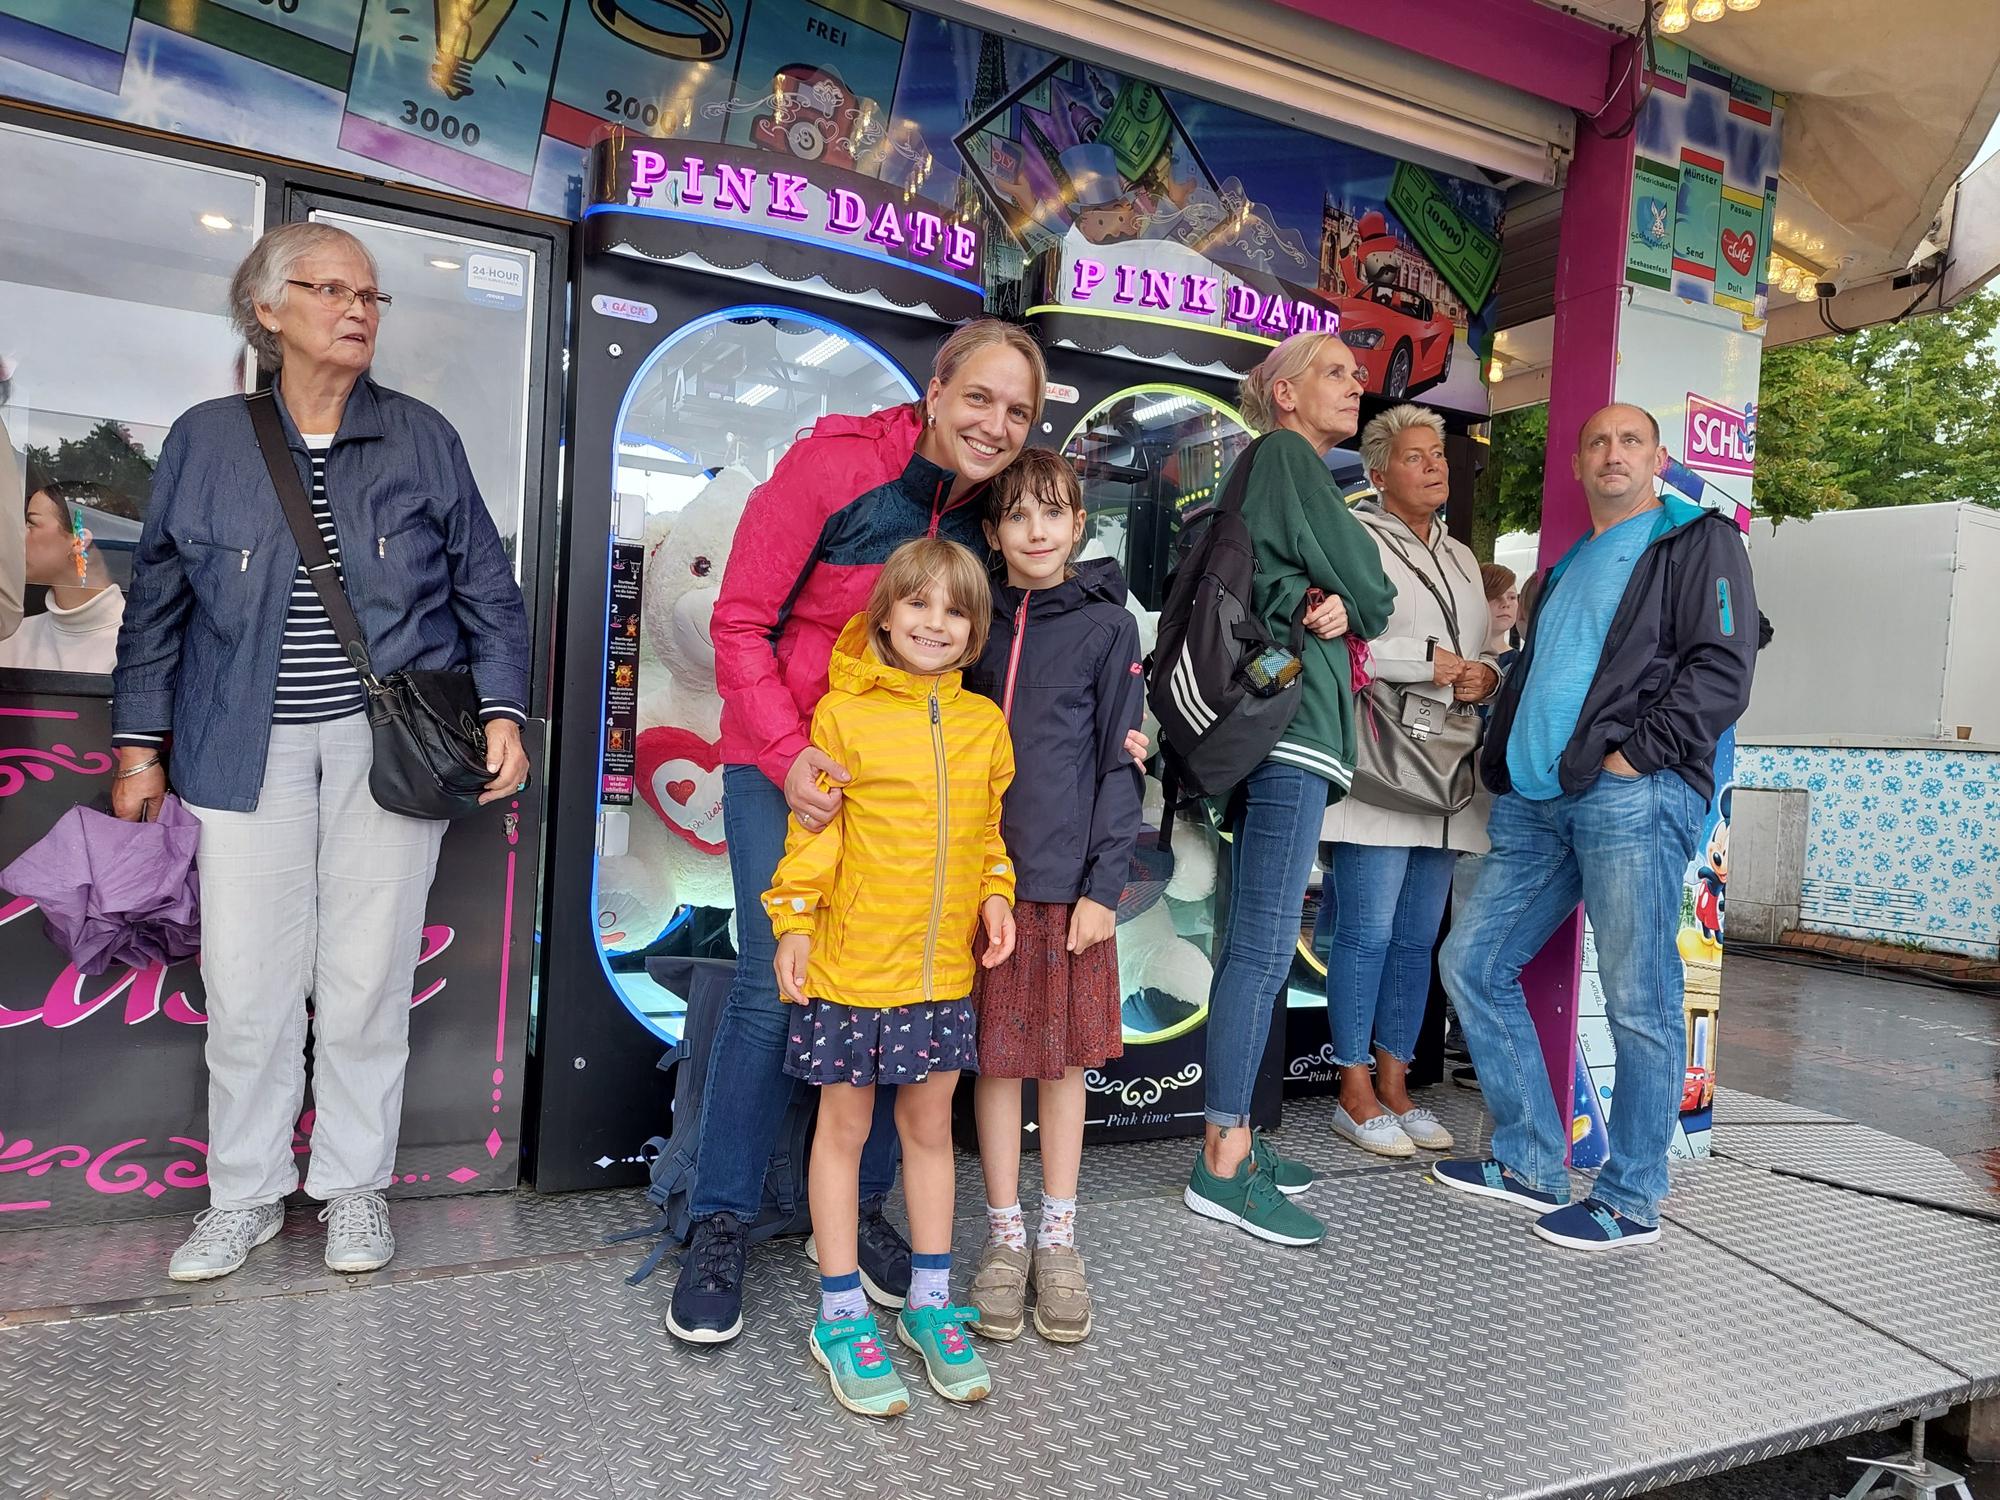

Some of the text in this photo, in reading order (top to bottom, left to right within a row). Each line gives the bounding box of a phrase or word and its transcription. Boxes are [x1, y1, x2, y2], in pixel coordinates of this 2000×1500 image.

[806, 16, 848, 48] FREI
[1646, 61, 1684, 80] Otoberfest
[604, 89, 677, 135] 2000
[399, 100, 480, 147] 3000
[1635, 173, 1677, 192] Friedrichshafen
[1684, 167, 1718, 186] Münster
[629, 149, 976, 270] PINK DATE
[1730, 203, 1753, 217] Passau
[1686, 246, 1705, 260] Send
[472, 265, 520, 282] 24-HOUR
[1629, 257, 1668, 275] Seehasenfest
[1071, 257, 1219, 315] PINK
[614, 549, 620, 559] 1
[610, 603, 618, 614] 2
[608, 660, 616, 670] 3
[606, 717, 614, 727] 4
[1308, 1069, 1333, 1082] Pink
[1106, 1110, 1171, 1127] Pink time
